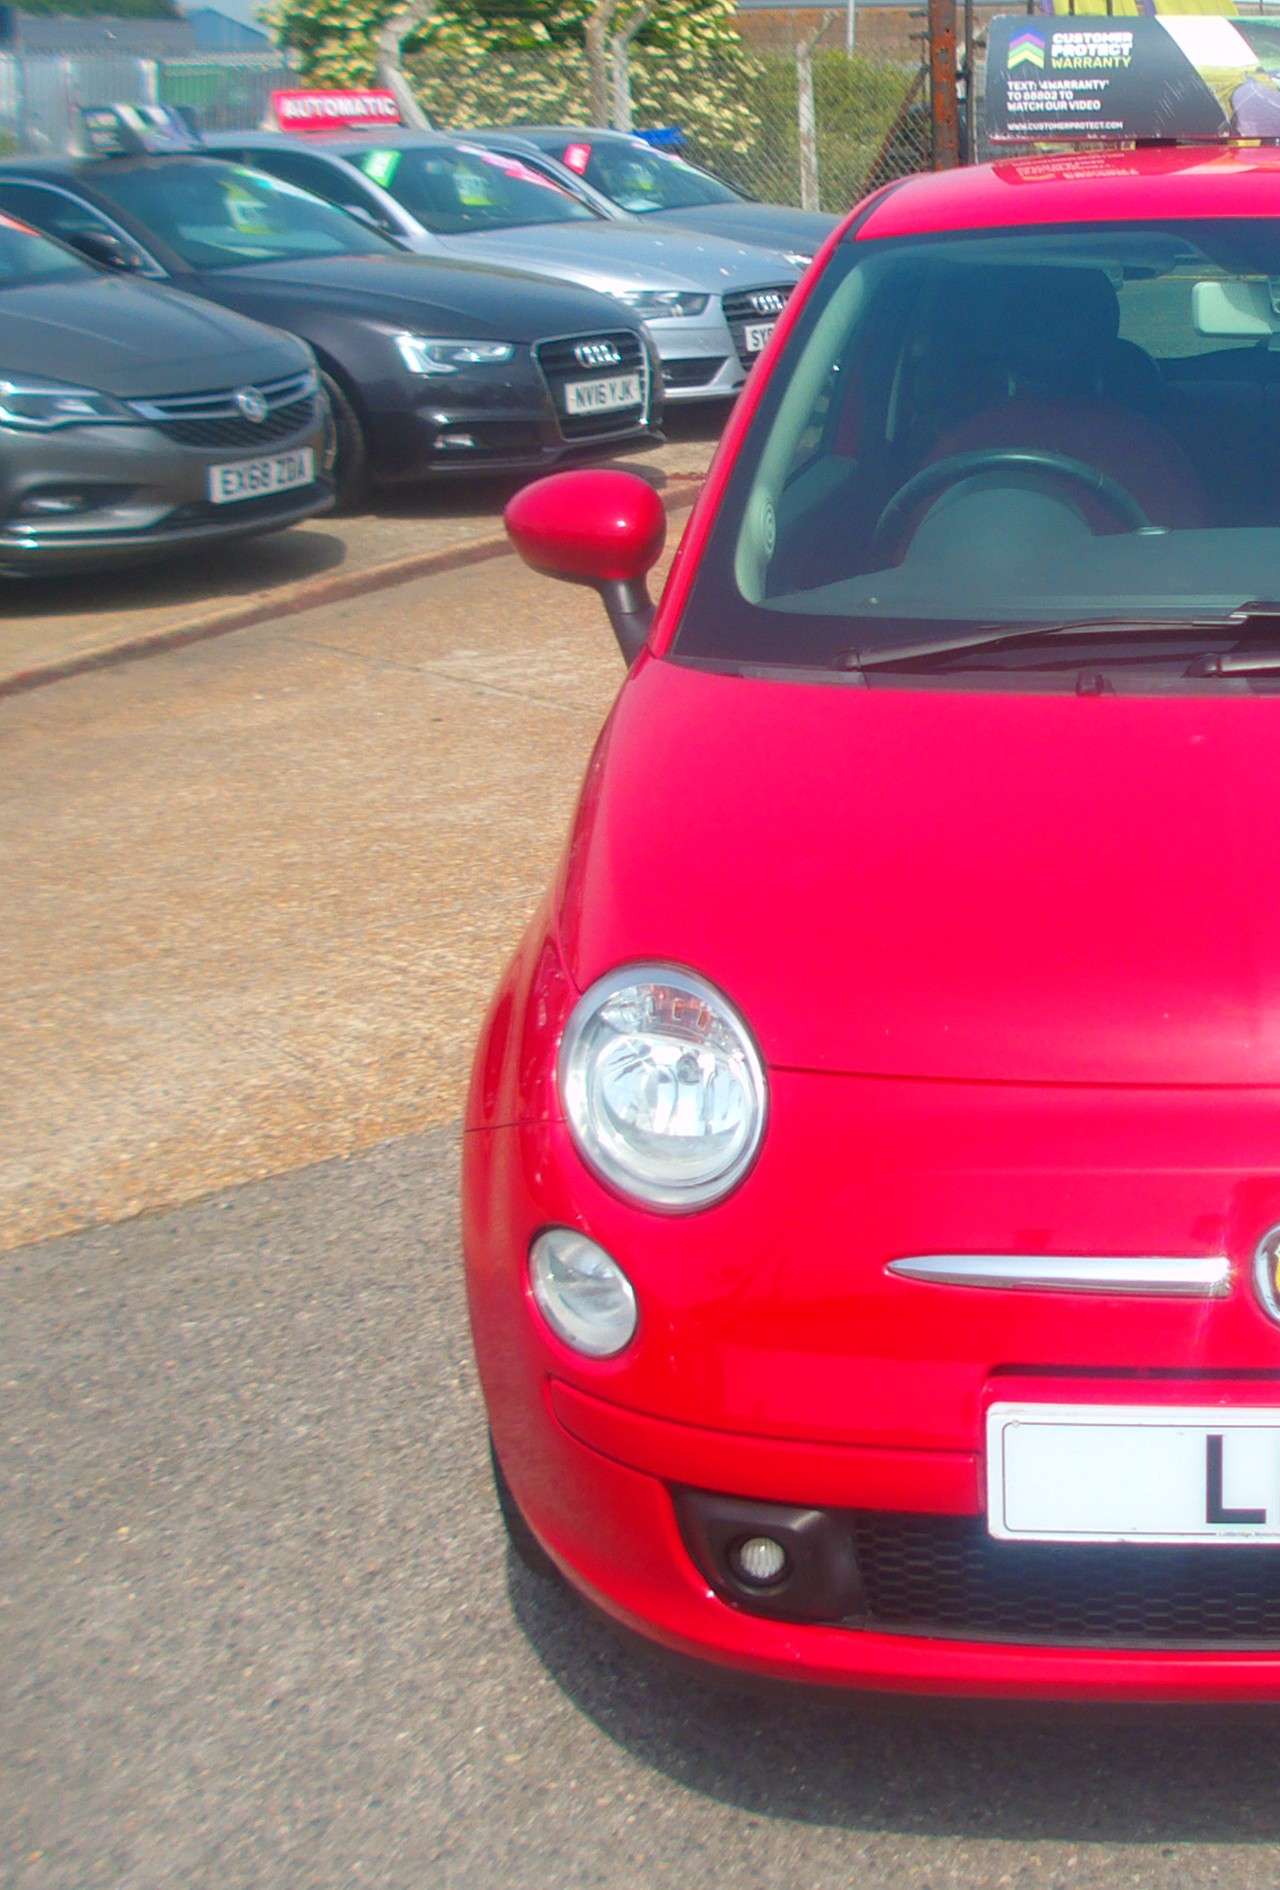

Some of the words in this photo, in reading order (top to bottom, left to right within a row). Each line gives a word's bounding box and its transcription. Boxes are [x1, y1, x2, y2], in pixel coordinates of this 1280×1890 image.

[1052, 32, 1133, 44] CUSTOMER
[1051, 44, 1132, 57] PROTECT
[1051, 56, 1132, 69] WARRANTY
[1007, 92, 1022, 101] TO
[1059, 91, 1073, 101] TO
[283, 96, 398, 118] AUTOMATIC
[1007, 102, 1045, 112] WATCH
[1047, 101, 1068, 112] OUR
[1069, 101, 1102, 111] VIDEO
